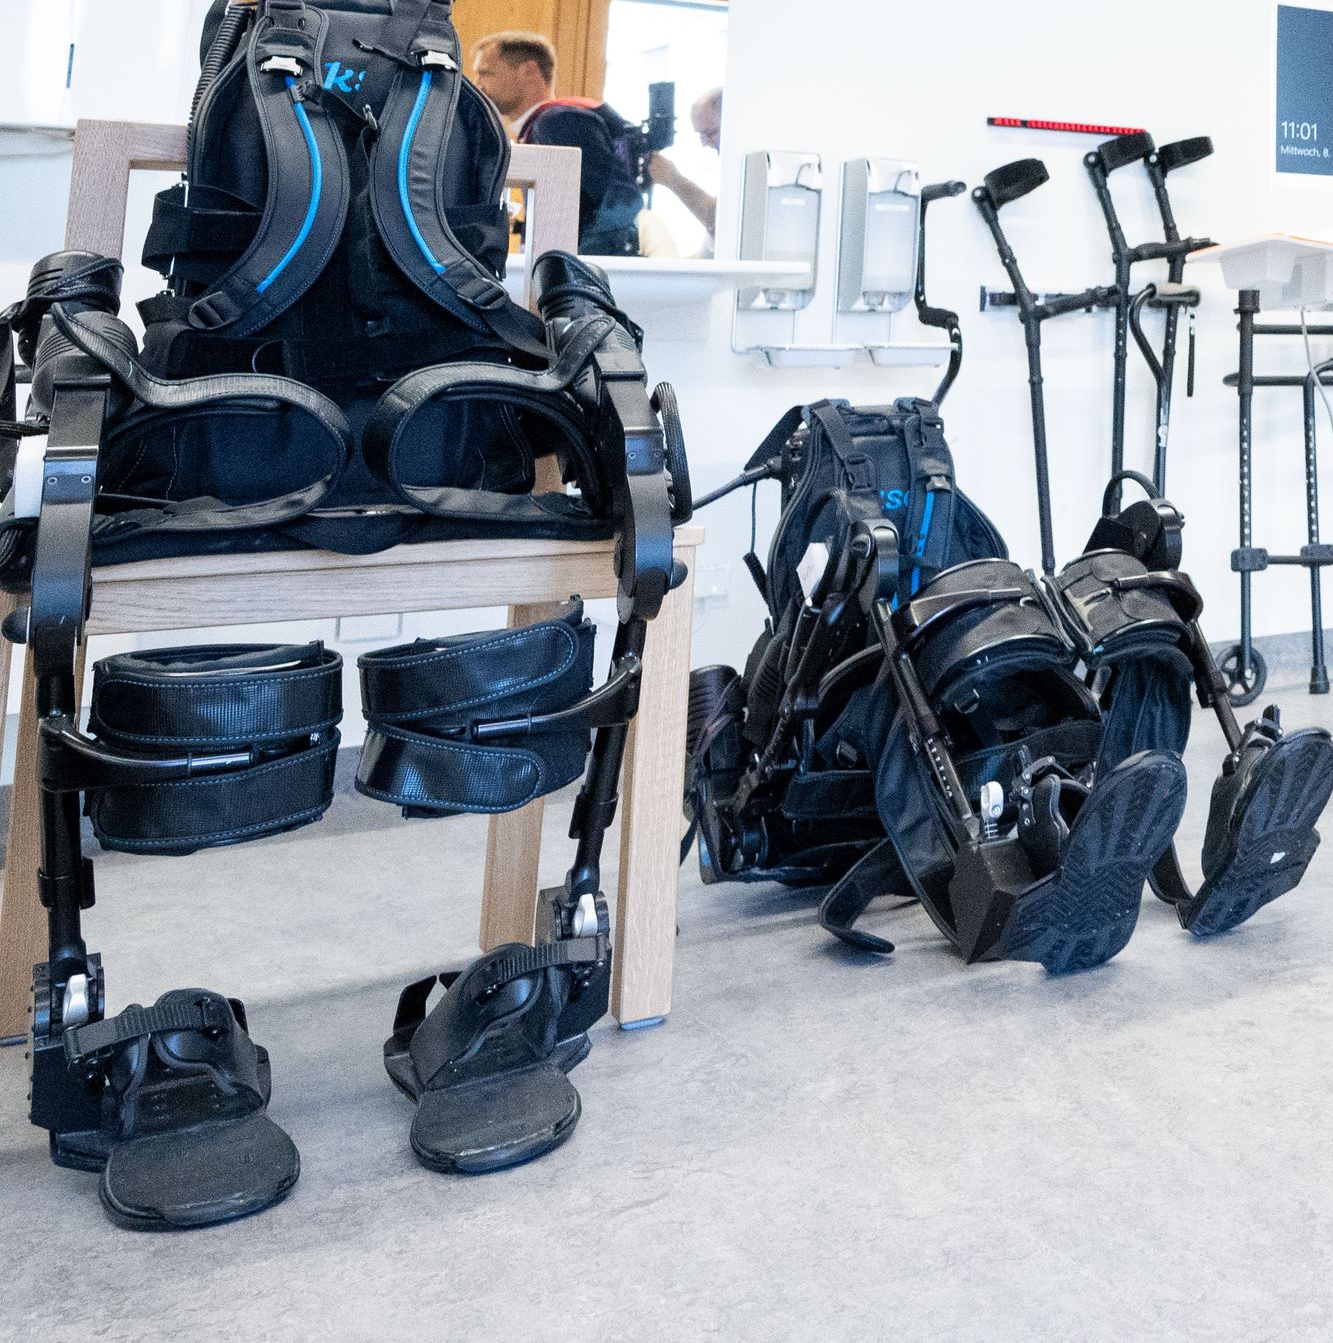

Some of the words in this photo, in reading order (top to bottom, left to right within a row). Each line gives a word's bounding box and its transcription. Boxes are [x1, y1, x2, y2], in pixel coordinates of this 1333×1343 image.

[1281, 120, 1318, 141] 11:01
[1280, 145, 1320, 158] Mittwoch,
[1322, 147, 1331, 158] 8.
